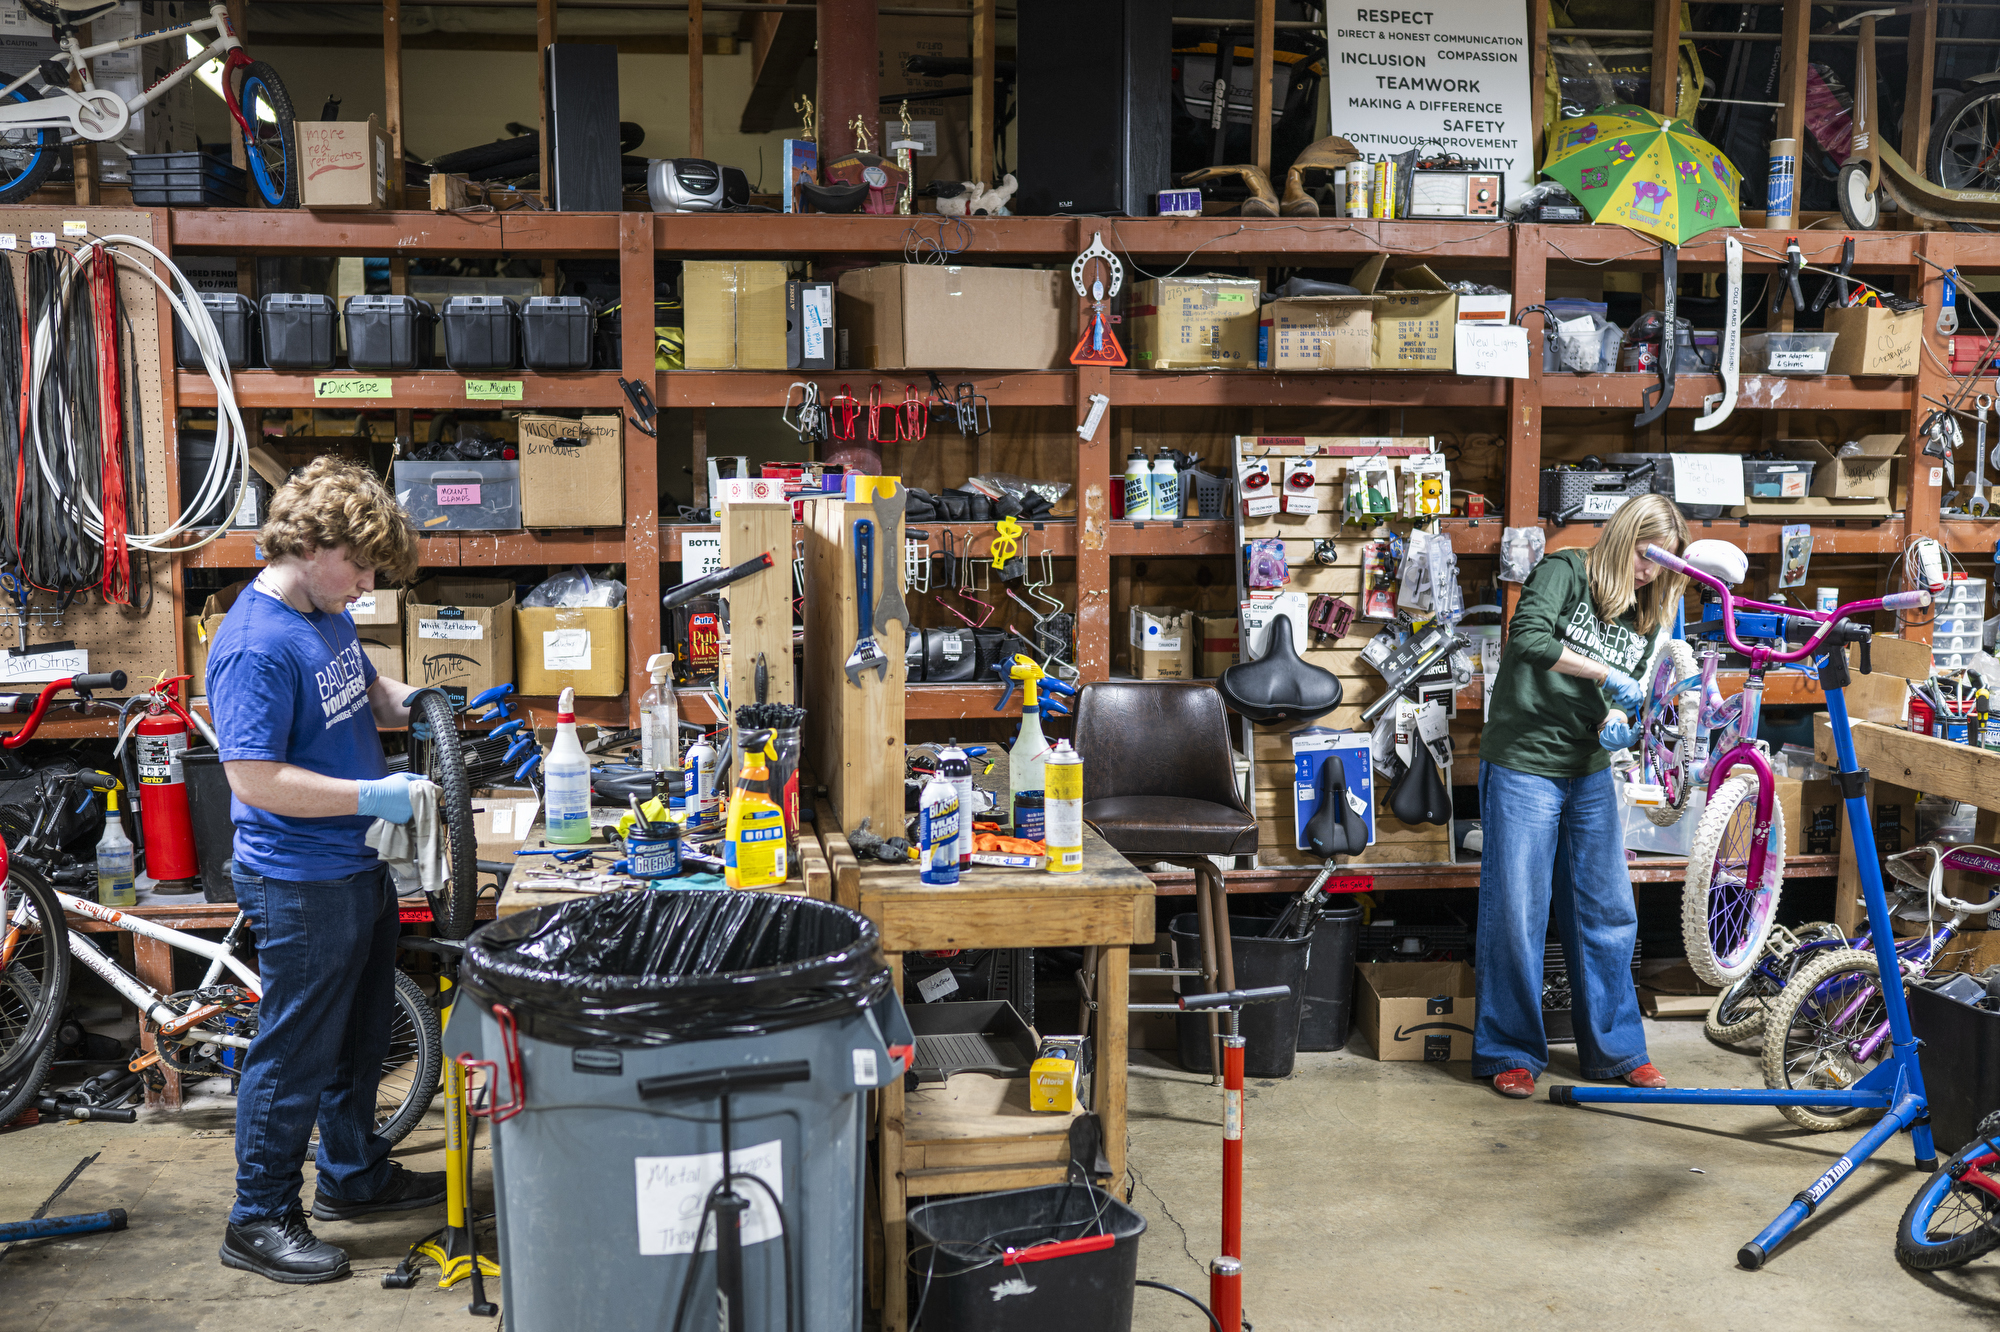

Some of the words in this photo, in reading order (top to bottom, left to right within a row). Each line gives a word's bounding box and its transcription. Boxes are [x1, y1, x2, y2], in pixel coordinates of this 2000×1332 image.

[1357, 8, 1434, 24] RESPECT
[16, 39, 38, 47] CAUTION
[1338, 29, 1376, 39] DIRECT
[1378, 32, 1386, 40] &
[1388, 32, 1430, 42] HONEST
[1434, 34, 1523, 46] COMMUNICATION
[1341, 52, 1426, 67] INCLUSION
[1438, 50, 1518, 62] COMPASSION
[1376, 76, 1480, 93] TEAMWORK
[1349, 97, 1402, 110] MAKING
[1406, 100, 1415, 110] A
[1420, 100, 1502, 113] DIFFERENCE
[1443, 119, 1505, 133] SAFETY
[306, 128, 344, 141] more
[1342, 132, 1425, 145] CONTINUOUS
[1429, 137, 1518, 149] IMPROVEMENT
[308, 140, 331, 156] red
[310, 150, 362, 169] reflectors
[1630, 208, 1662, 228] Barney
[186, 269, 207, 278] USED
[211, 270, 238, 278] FEND
[1467, 333, 1489, 348] New
[1492, 333, 1518, 351] Lights
[1478, 350, 1498, 358] (red)
[1729, 330, 1737, 372] REFRESHING
[352, 381, 378, 393] Tape
[467, 382, 487, 392] Misc.
[489, 382, 516, 393] Mounts
[562, 424, 617, 437] reflectors
[527, 443, 537, 455] &
[539, 444, 580, 458] mounts
[1679, 455, 1712, 470] Metal
[1685, 472, 1700, 482] Toe
[1705, 473, 1725, 485] Clips
[1843, 465, 1866, 479] Repair
[1867, 467, 1886, 481] Bolts
[1125, 478, 1142, 490] BIKE
[1159, 478, 1177, 490] BIKE
[1162, 485, 1177, 496] THE
[440, 487, 468, 495] MOUNT
[1126, 486, 1142, 496] THE
[1160, 493, 1178, 503] 'BUR
[1589, 498, 1618, 511] Bells
[1400, 610, 1412, 622] PRO
[693, 631, 717, 644] Pub
[693, 643, 717, 655] Mix
[5, 657, 37, 674] Rim
[40, 654, 80, 671] Strips
[424, 656, 464, 684] White
[142, 776, 164, 784] sentry
[1880, 821, 1899, 829] prime
[635, 852, 676, 874] GREASE
[1951, 853, 1980, 867] Dazzle
[1340, 881, 1349, 890] for
[1037, 1074, 1064, 1086] Vittoria
